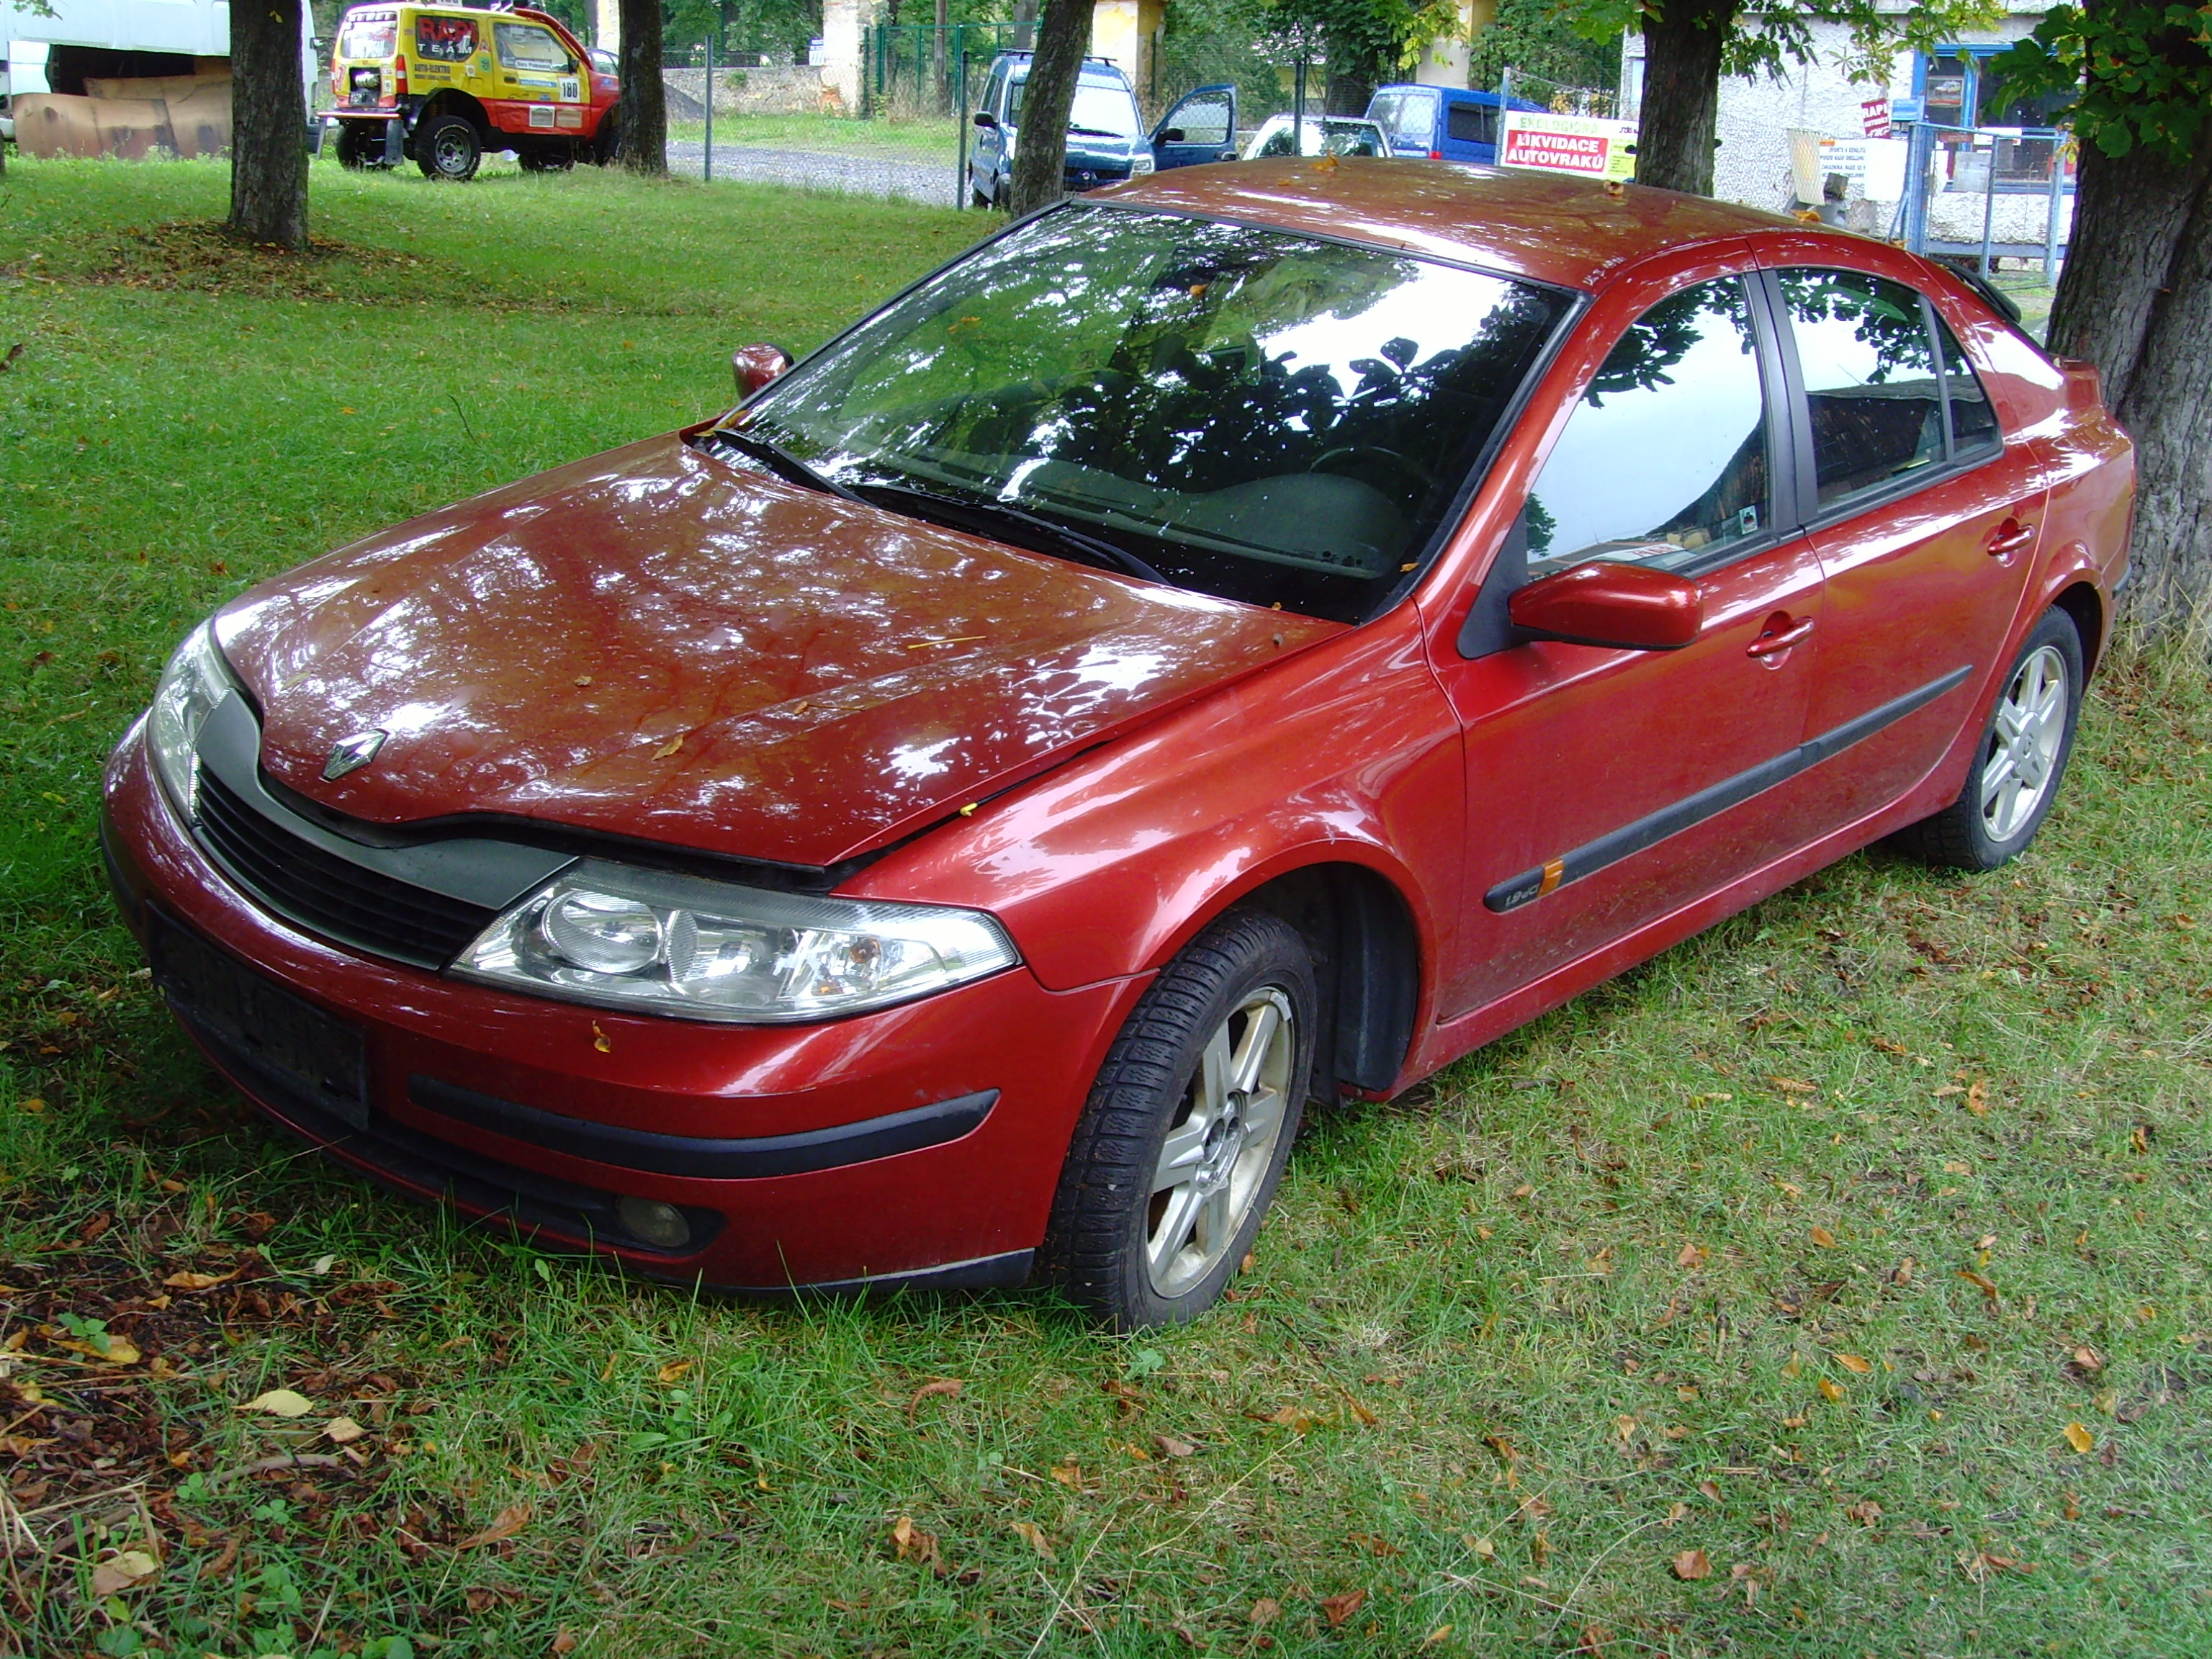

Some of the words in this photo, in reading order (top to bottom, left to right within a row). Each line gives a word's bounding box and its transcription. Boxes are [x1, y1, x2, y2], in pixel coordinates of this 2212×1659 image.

[418, 43, 472, 54] TEAM
[562, 82, 577, 98] 180
[1861, 103, 1887, 118] RAPI
[1516, 133, 1600, 153] LIKVIDACE
